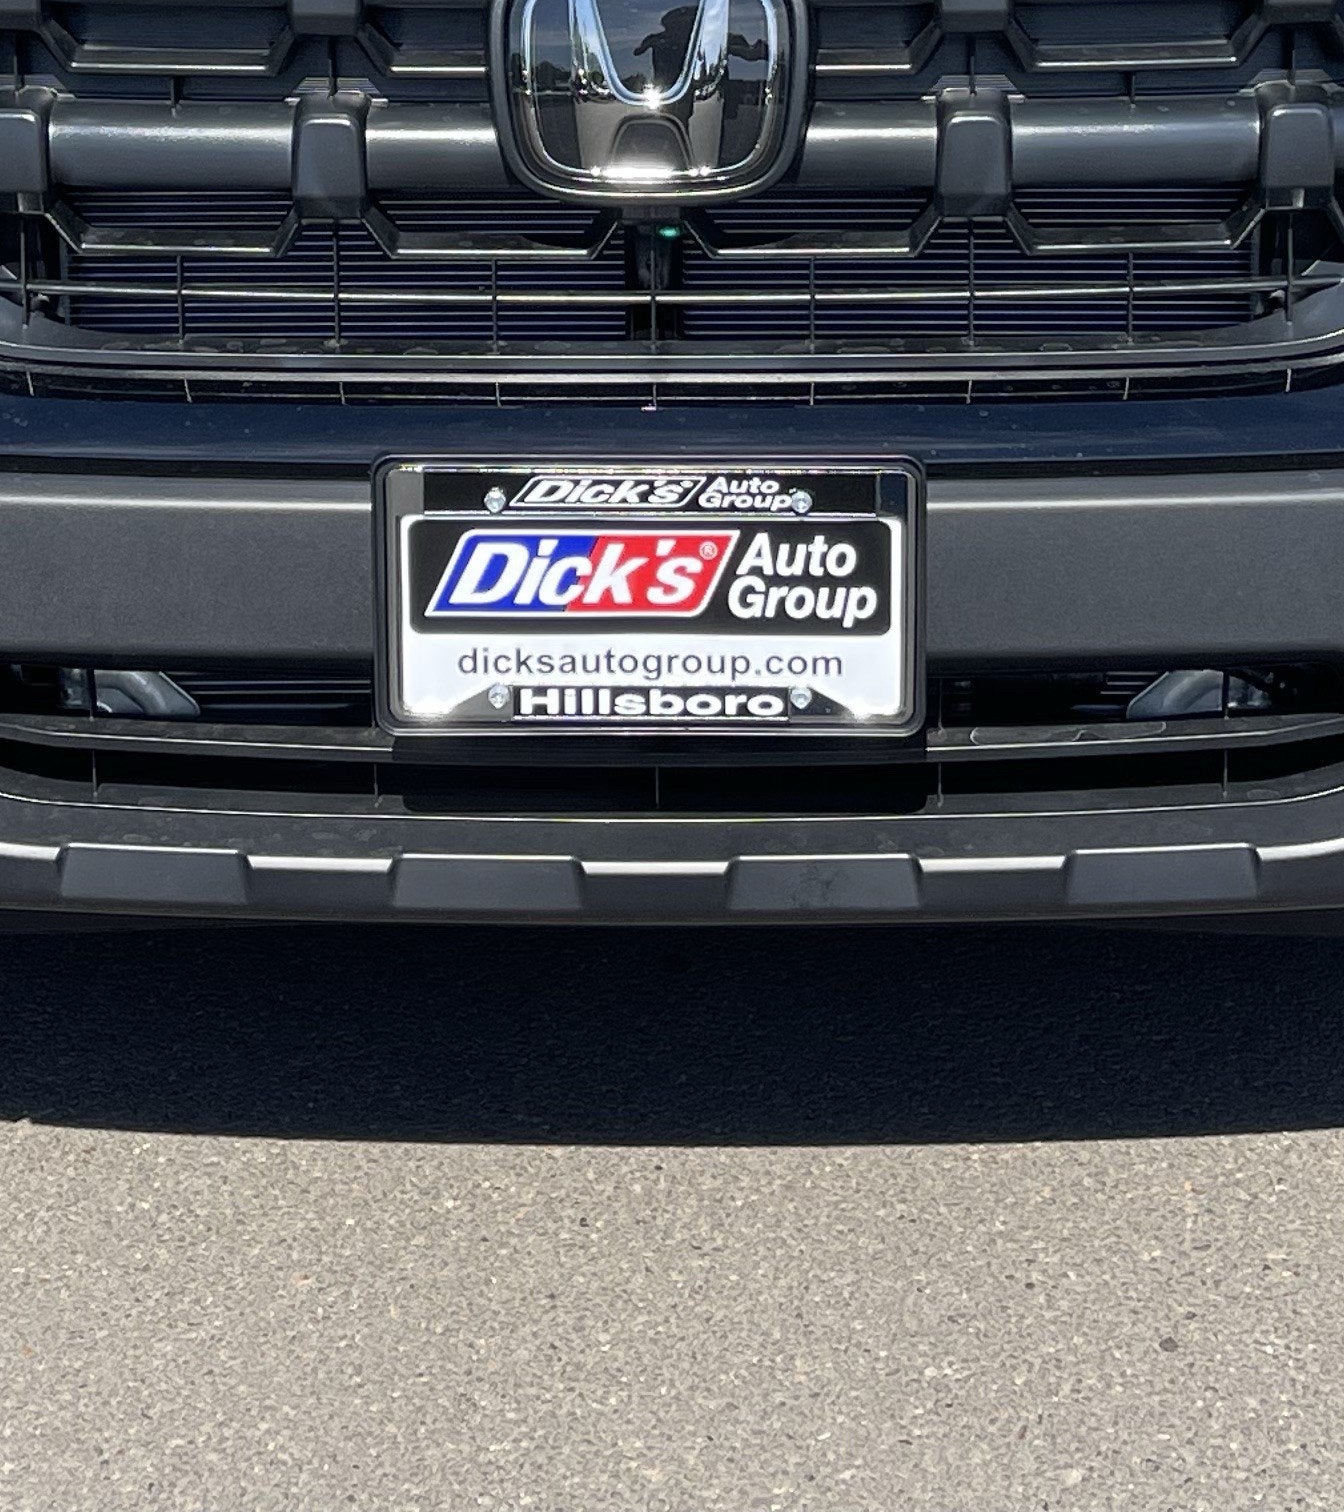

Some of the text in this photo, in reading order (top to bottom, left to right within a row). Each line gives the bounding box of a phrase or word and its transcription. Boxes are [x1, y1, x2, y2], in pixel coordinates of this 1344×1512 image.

[523, 478, 684, 504] Dick's
[705, 476, 780, 494] Auto
[697, 491, 793, 512] Group
[736, 533, 857, 577] Auto
[448, 539, 705, 606] Dick's
[727, 579, 877, 628] Group
[457, 647, 844, 680] dicksautogroup.com
[519, 687, 785, 717] Hillsboro
